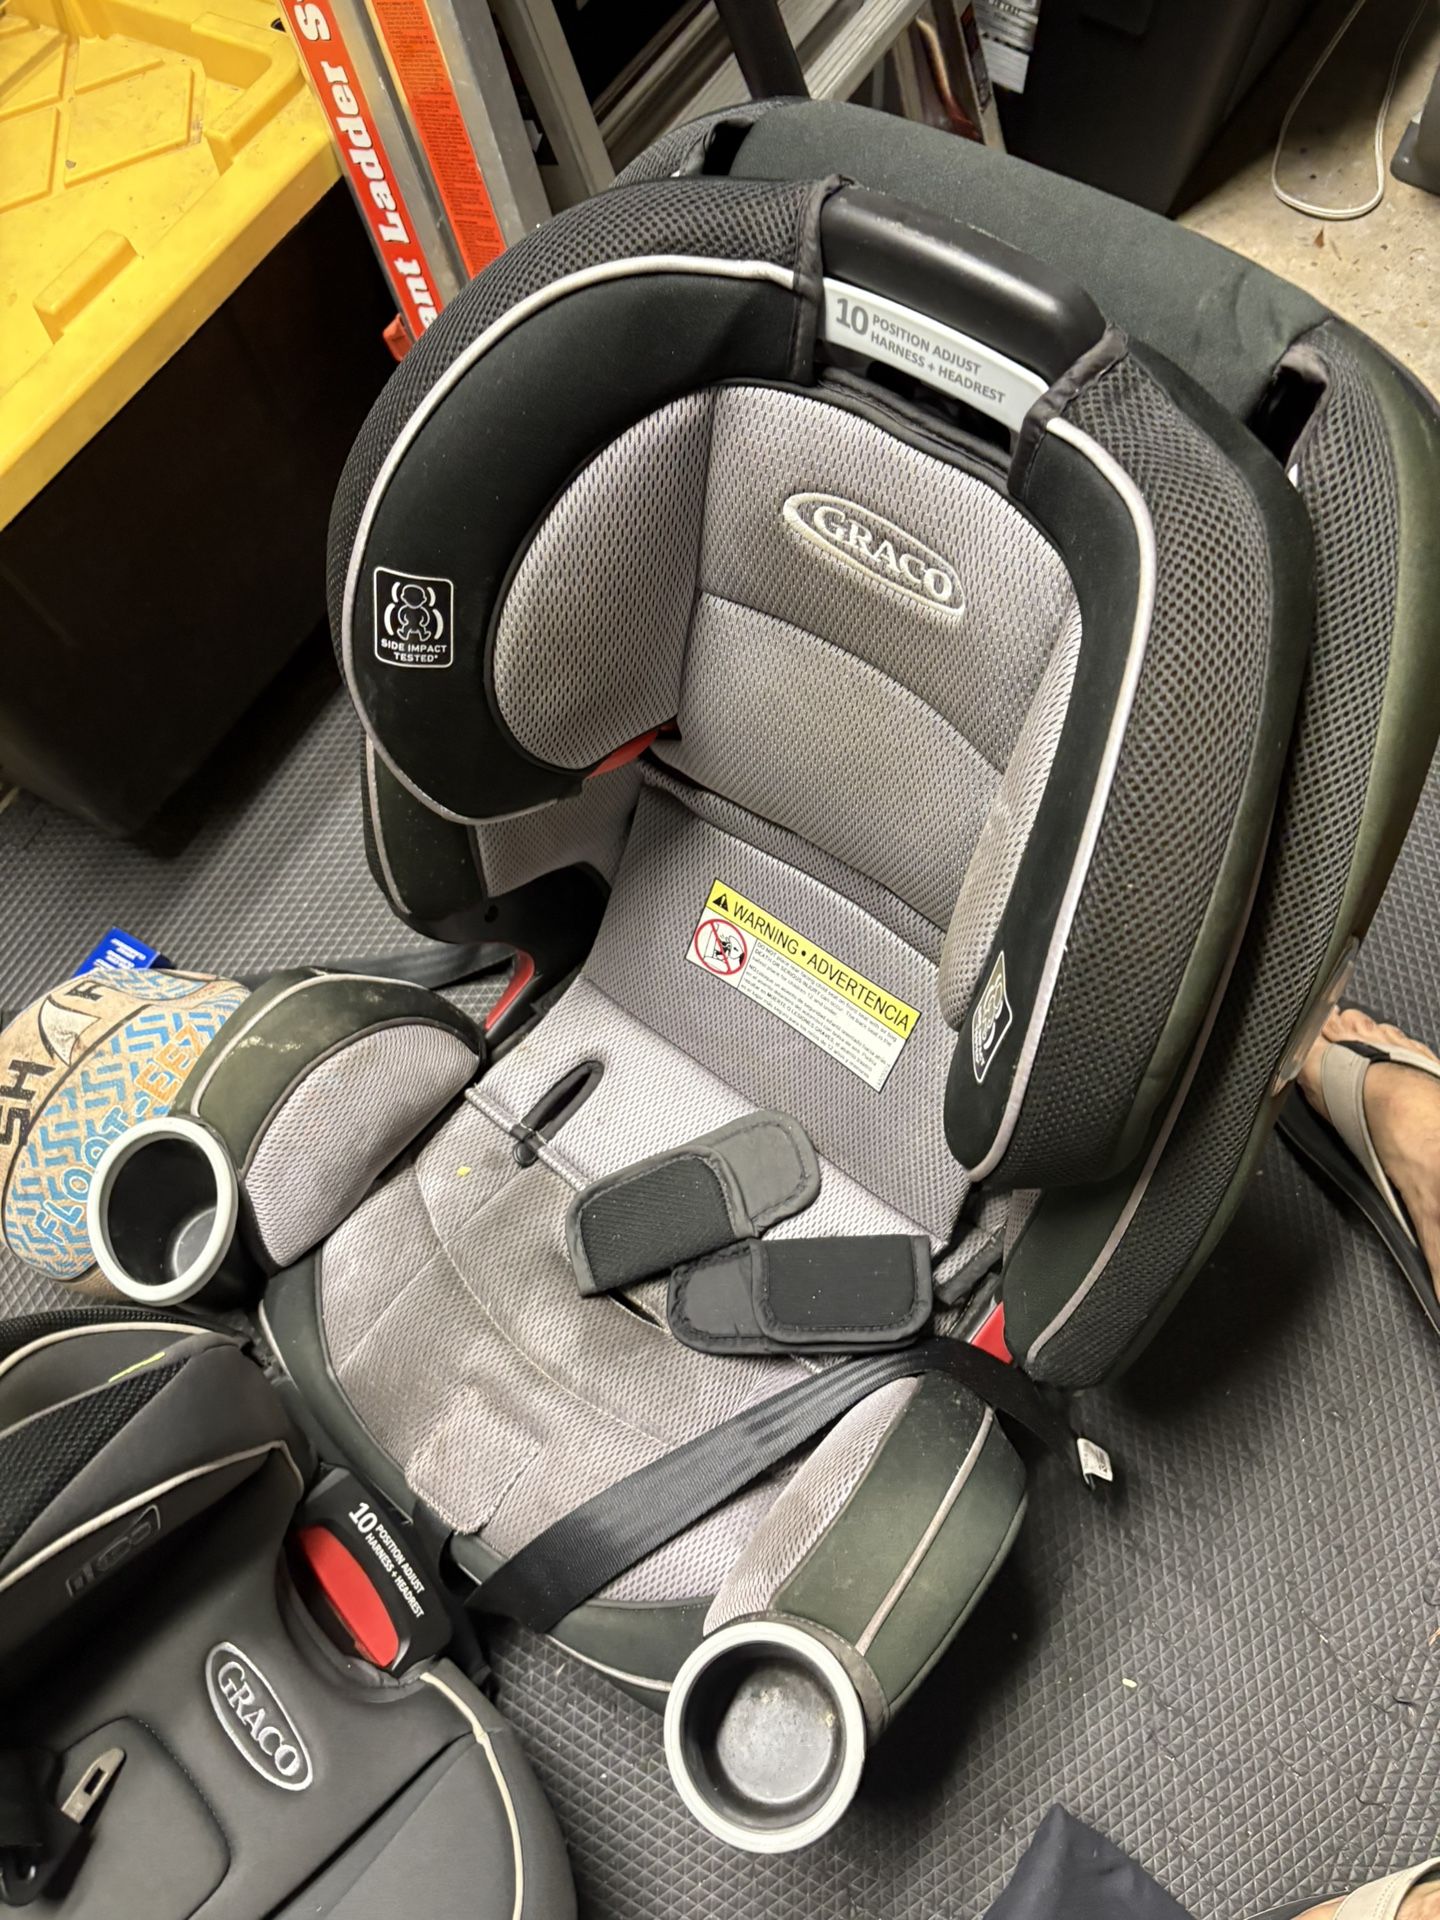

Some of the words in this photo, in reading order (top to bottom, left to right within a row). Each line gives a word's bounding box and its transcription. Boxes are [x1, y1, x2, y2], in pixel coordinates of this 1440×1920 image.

[293, 0, 331, 41] S
[320, 61, 410, 243] Ladder
[836, 298, 869, 336] 10
[871, 314, 930, 353] POSITION
[932, 344, 982, 375] ADJUST
[871, 332, 925, 369] HARNESS
[928, 362, 936, 374] +
[938, 367, 1006, 404] HEADREST
[813, 505, 952, 601] GRACO
[380, 638, 405, 652] SIDE
[407, 643, 448, 654] IMPACT
[733, 901, 800, 955] WARNING
[806, 953, 910, 1032] ADVERTENCIA
[754, 947, 772, 963] DEATH
[780, 965, 802, 983] SERIOUS
[765, 946, 776, 957] NOT
[348, 1502, 378, 1533] 10
[375, 1523, 406, 1565] POSITION
[401, 1562, 425, 1594] ADJUST
[365, 1532, 395, 1573] HARNESS
[394, 1575, 425, 1618] HEADREST
[217, 1661, 300, 1776] GRACO
